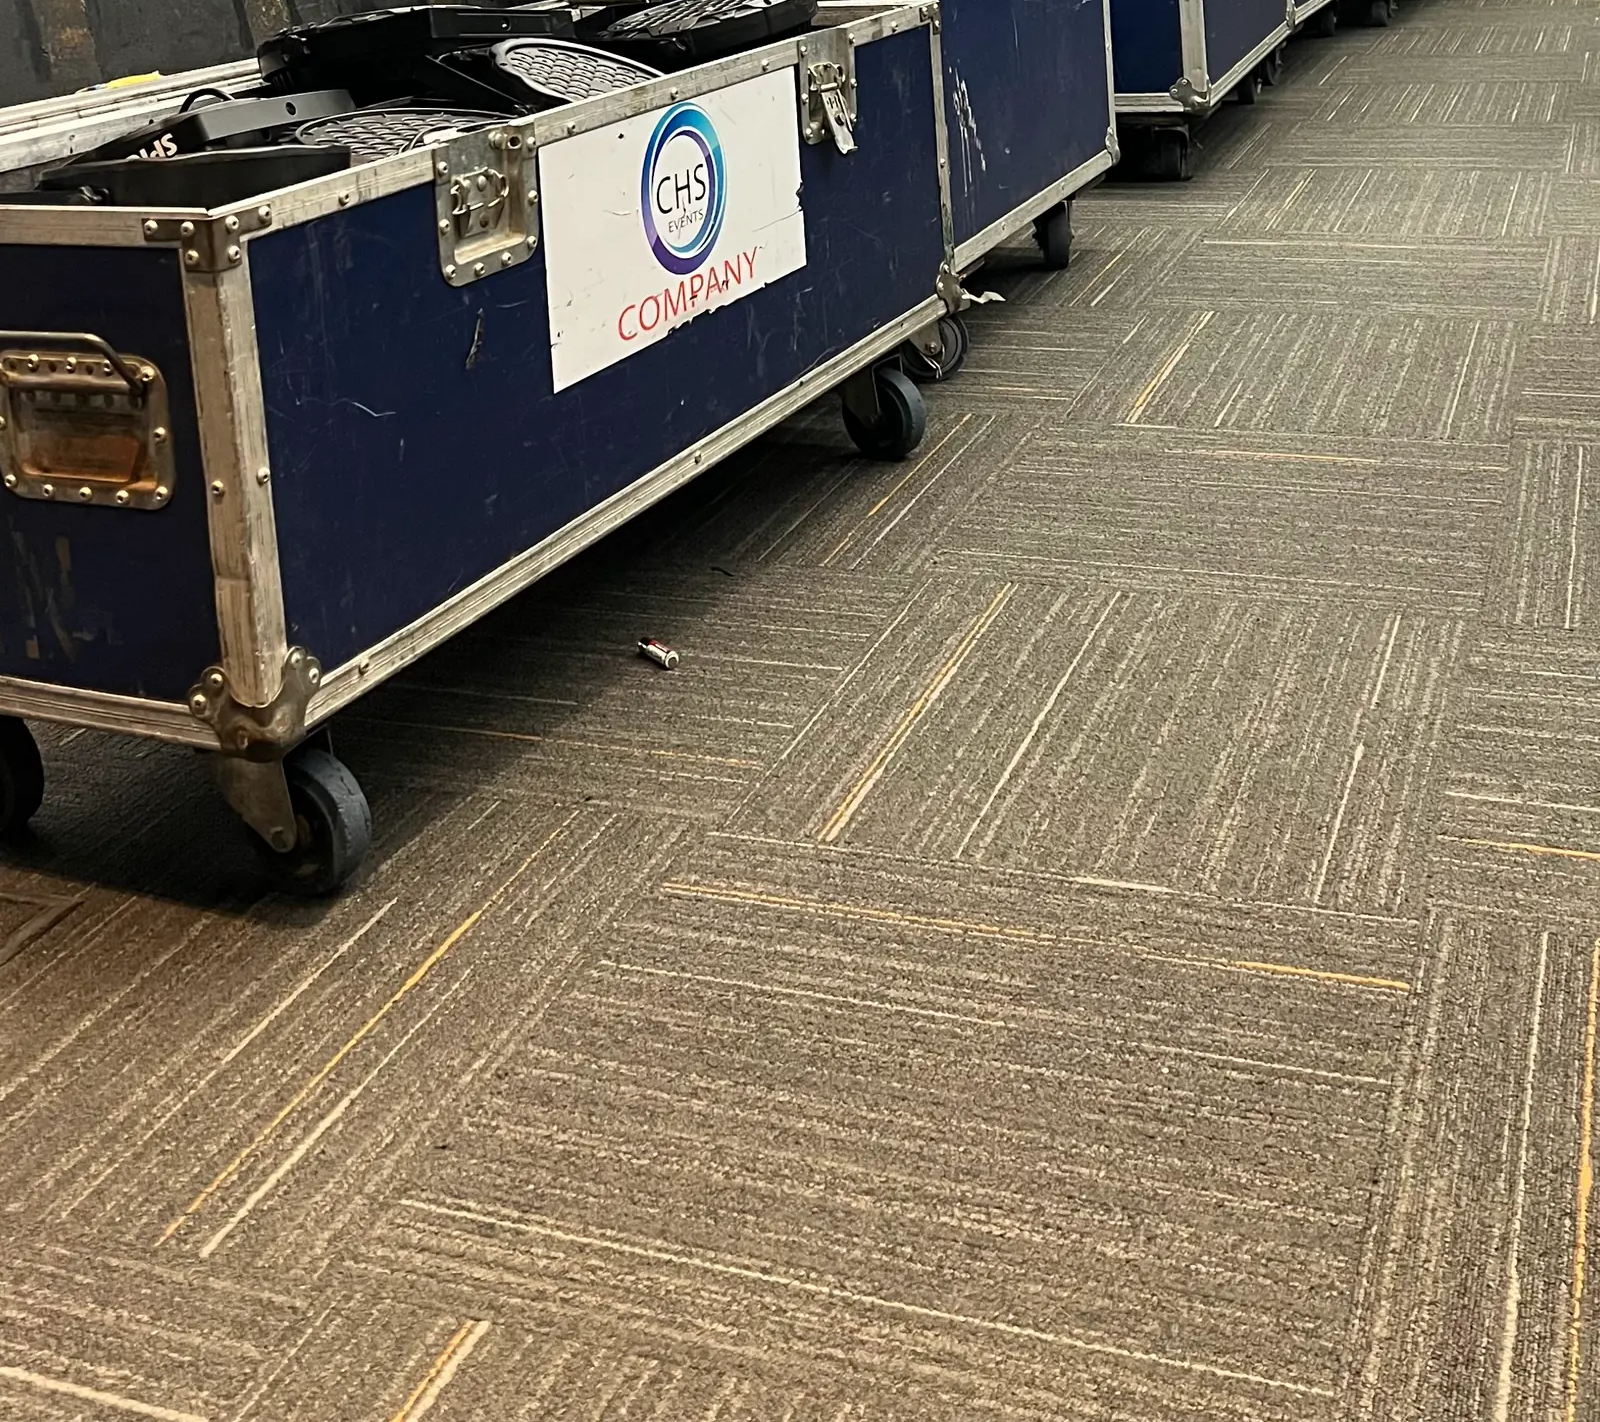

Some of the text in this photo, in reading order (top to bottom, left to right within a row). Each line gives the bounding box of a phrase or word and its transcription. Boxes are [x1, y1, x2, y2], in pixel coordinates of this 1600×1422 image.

[656, 163, 706, 215] CHS
[668, 209, 705, 233] EVENTS
[617, 246, 758, 342] COMPANY
